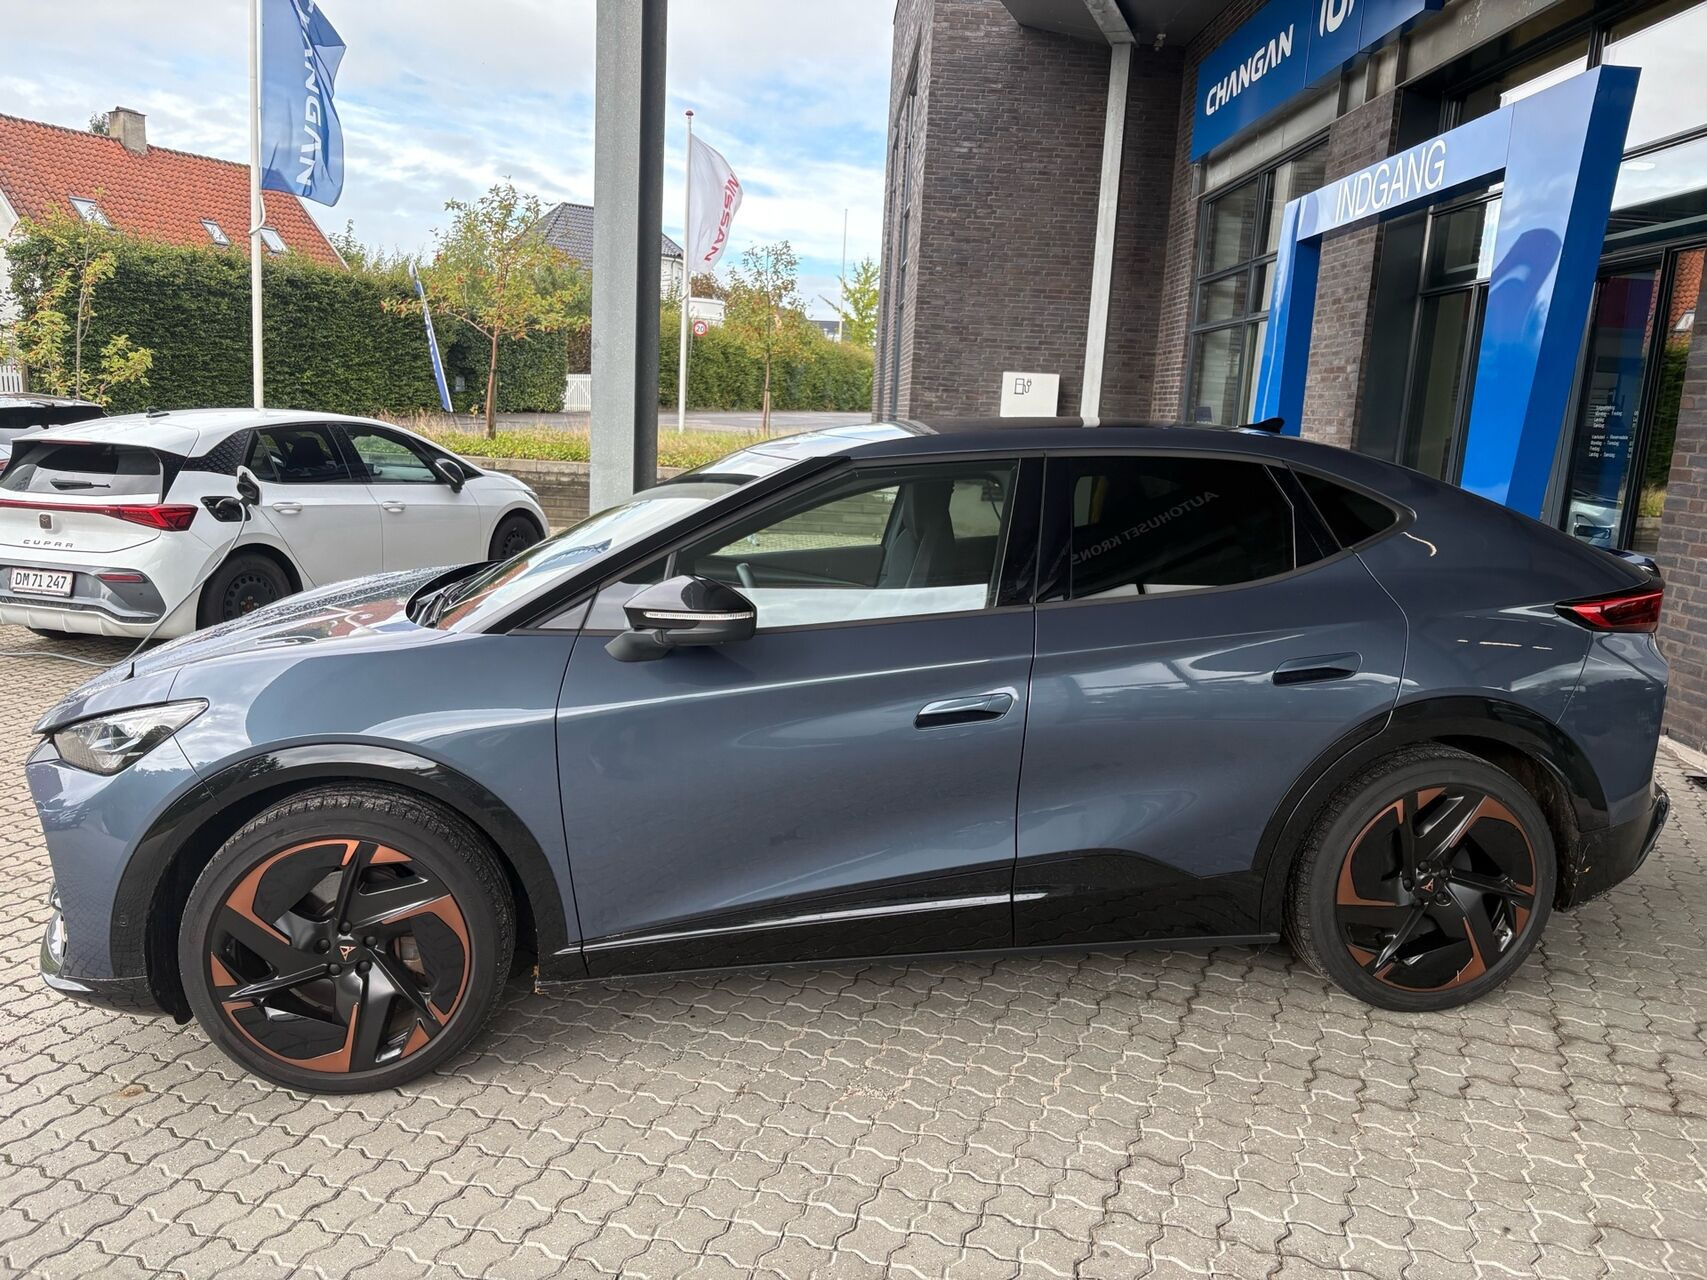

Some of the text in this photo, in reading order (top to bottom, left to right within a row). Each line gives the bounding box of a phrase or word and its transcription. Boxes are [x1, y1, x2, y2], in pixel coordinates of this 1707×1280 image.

[1205, 24, 1294, 116] CHANGAN
[704, 174, 739, 262] NISSAN
[1335, 139, 1446, 224] INDGANG
[15, 572, 67, 589] DM 71 247
[23, 539, 74, 548] CUPRA
